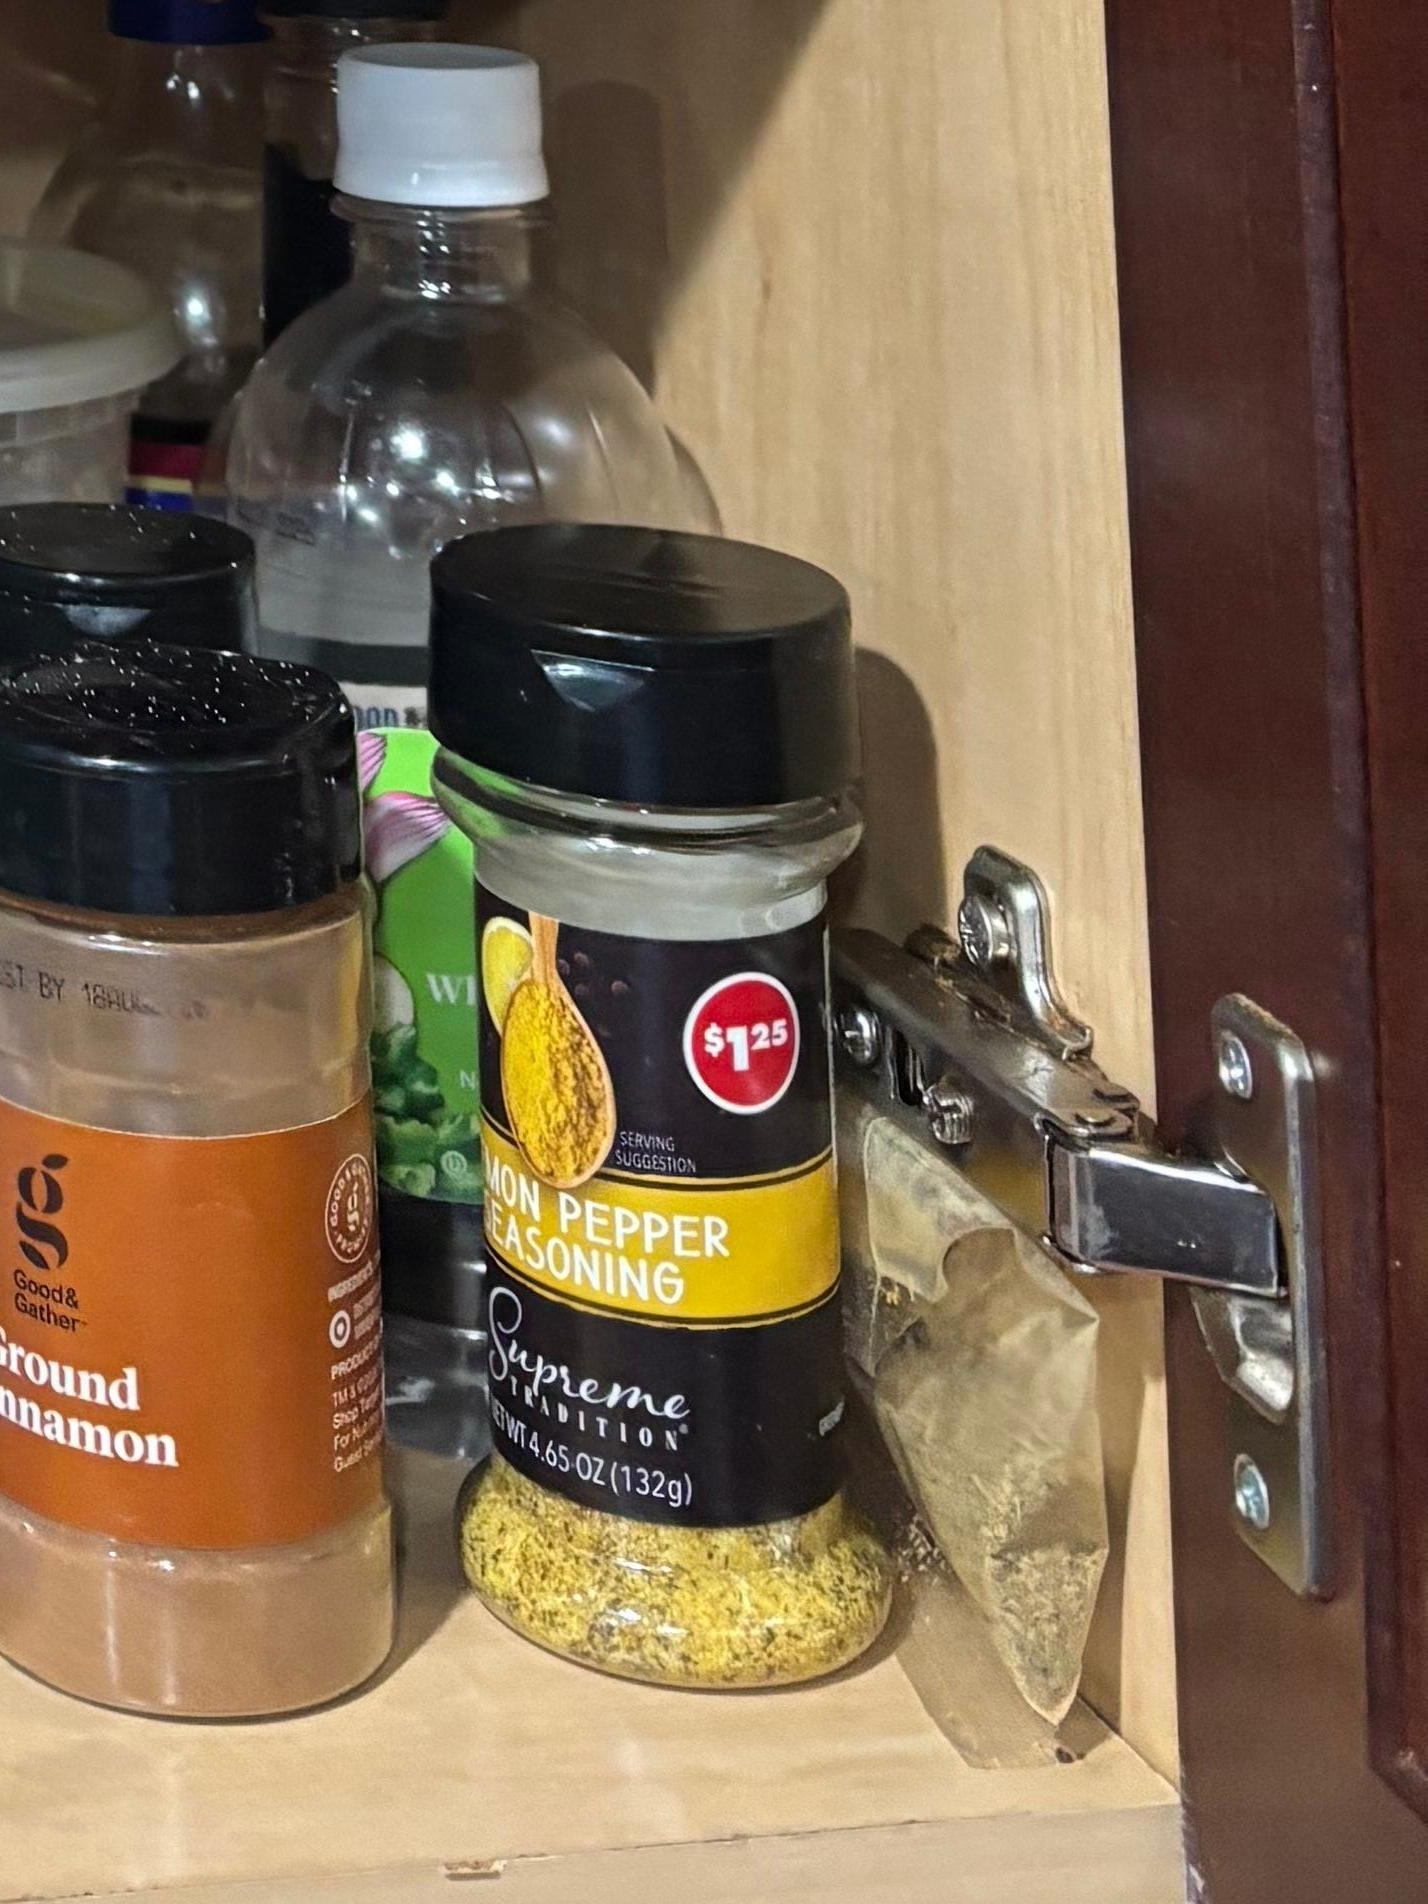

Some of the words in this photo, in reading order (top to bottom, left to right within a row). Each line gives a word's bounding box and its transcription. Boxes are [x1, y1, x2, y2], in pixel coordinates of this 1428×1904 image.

[39, 971, 65, 1003] BY
[620, 1131, 675, 1153] SERVING
[615, 1149, 697, 1174] SUGGESTION
[485, 1159, 541, 1217] MON
[557, 1191, 730, 1259] PEPPER
[14, 1269, 79, 1310] Good&
[488, 1286, 691, 1420] Supreme
[508, 1373, 680, 1452] TRADITION
[576, 1452, 605, 1487] OZ
